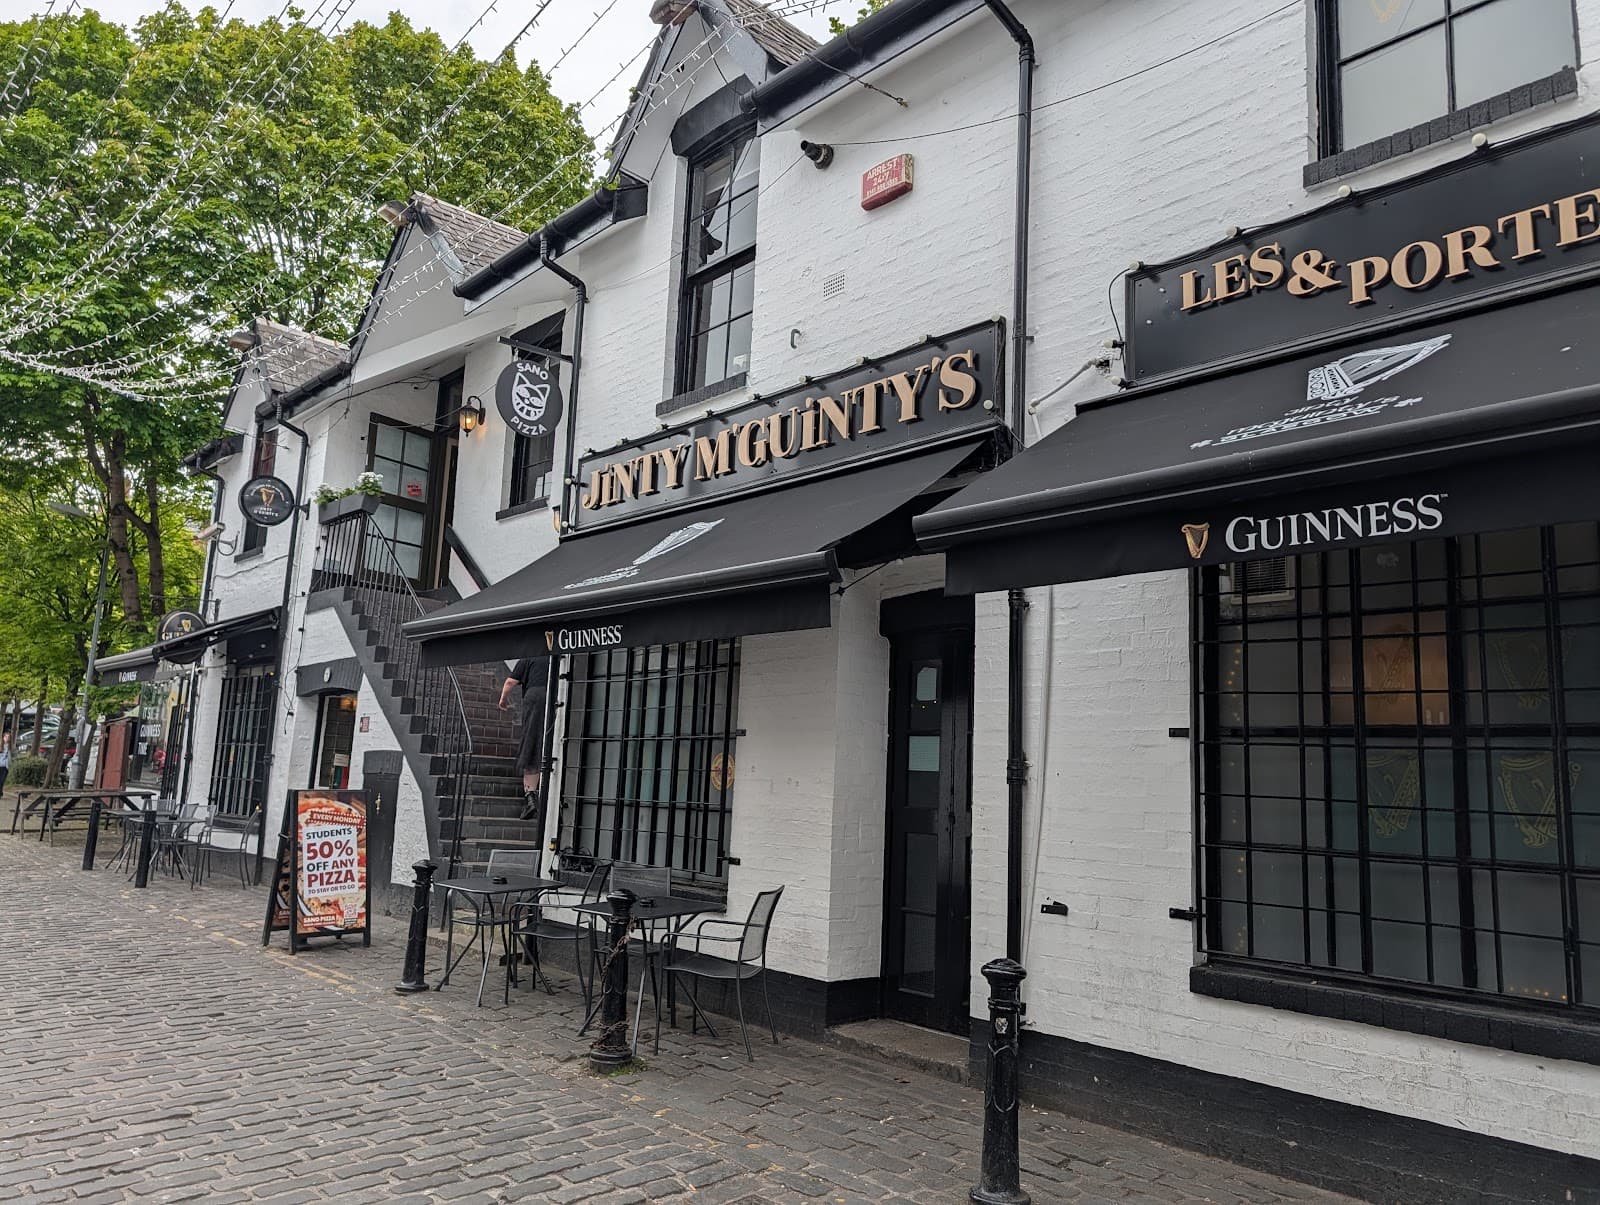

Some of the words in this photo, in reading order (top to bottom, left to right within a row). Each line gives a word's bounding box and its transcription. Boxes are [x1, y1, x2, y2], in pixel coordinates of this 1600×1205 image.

[517, 363, 549, 380] SANO
[511, 416, 547, 435] PIZZA
[1225, 494, 1443, 552] GUINNESS
[558, 625, 622, 649] GUINNESS
[313, 813, 332, 821] EVERY
[334, 815, 361, 824] MONDAY
[306, 827, 352, 840] STUDENTS
[307, 839, 353, 860] 50%
[307, 861, 329, 872] OFF
[332, 858, 355, 869] ANY
[308, 870, 356, 887] PIZZA
